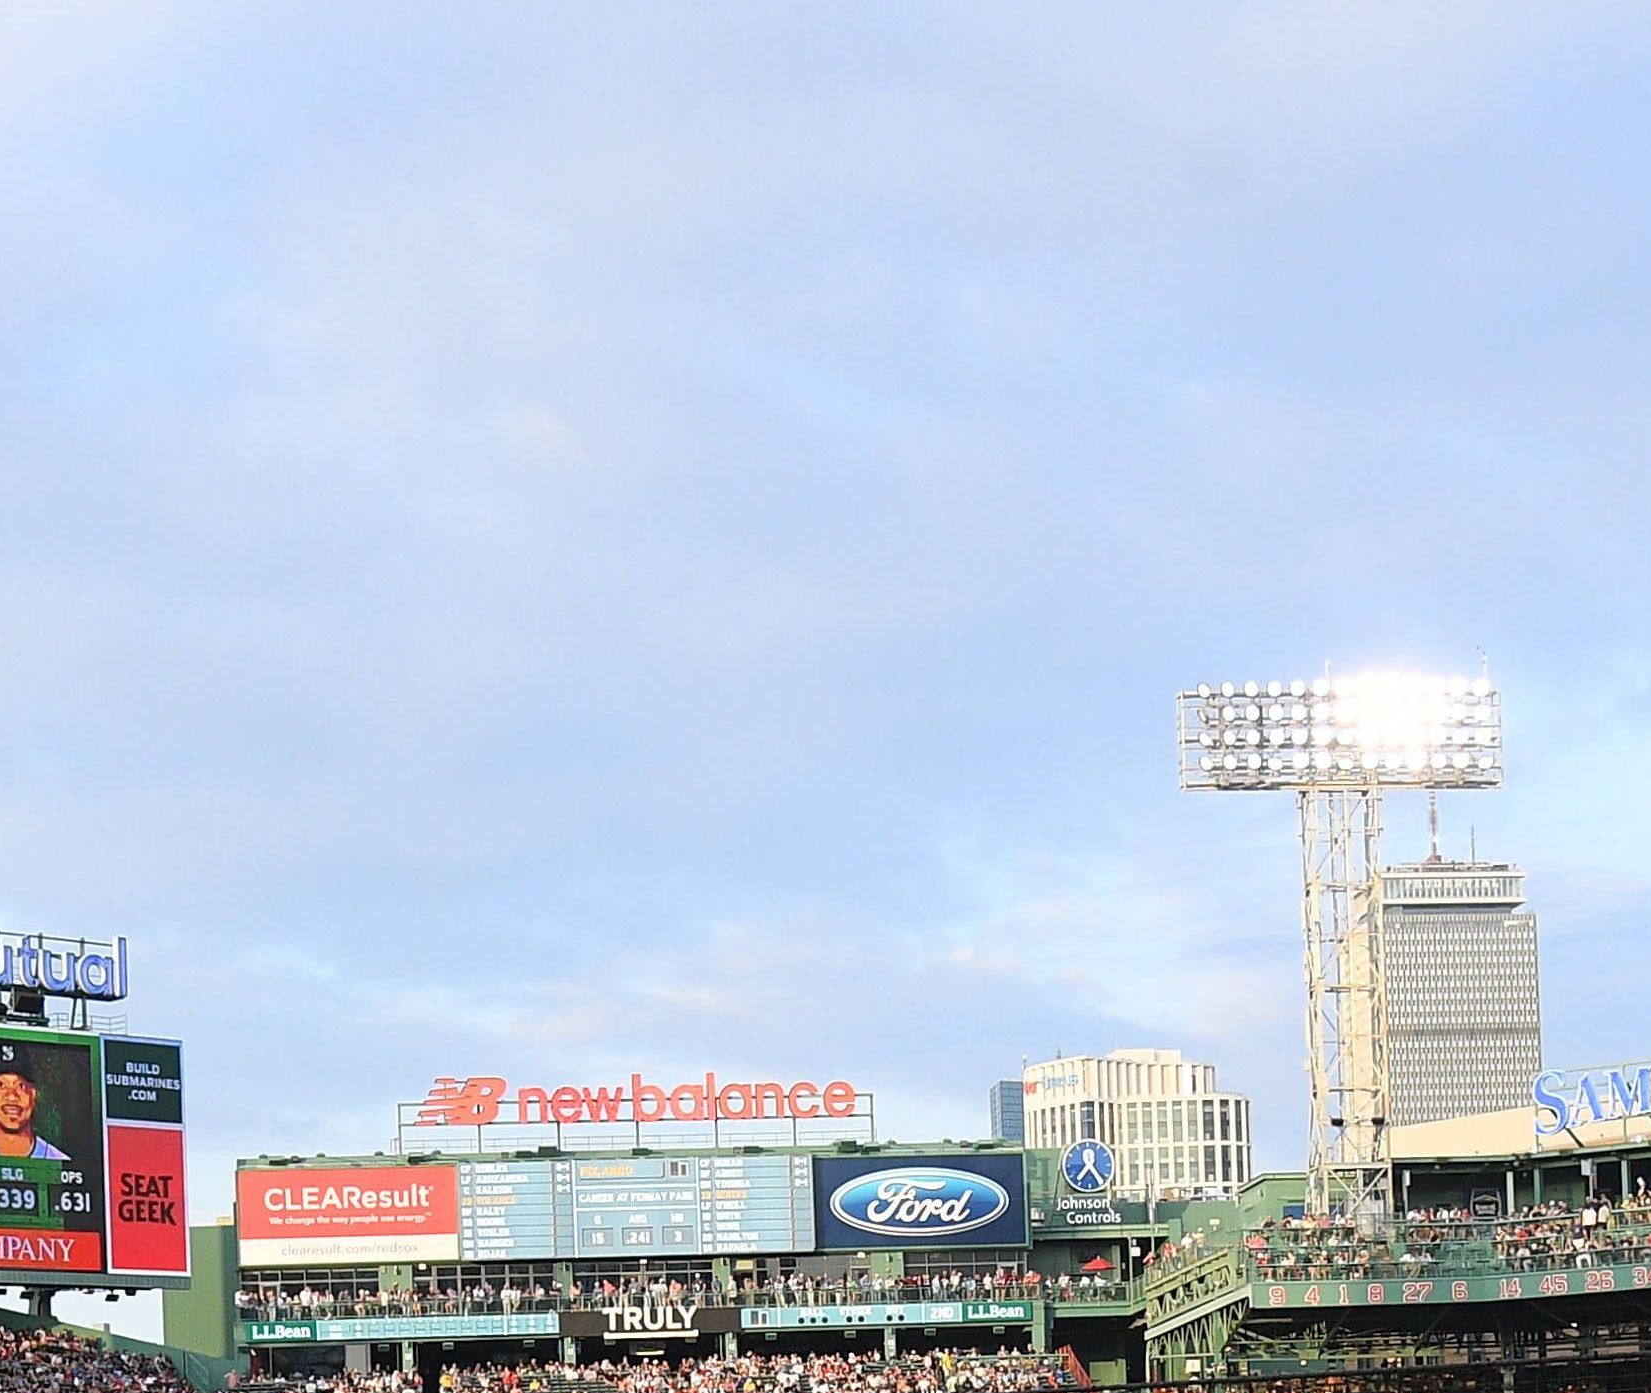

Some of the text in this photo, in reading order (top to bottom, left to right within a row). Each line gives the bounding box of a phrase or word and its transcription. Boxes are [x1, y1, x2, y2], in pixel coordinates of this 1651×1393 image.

[125, 1061, 161, 1075] BUILD
[106, 1075, 181, 1091] SUBMARINES
[60, 1170, 84, 1185] OPS
[120, 1172, 173, 1199] SEAT
[54, 1191, 91, 1213] .631
[263, 1182, 430, 1213] CLEAResult
[866, 1178, 974, 1224] Ford
[1056, 1194, 1112, 1212] Johnson
[117, 1199, 178, 1226] GEEK
[268, 1215, 284, 1226] We
[284, 1214, 315, 1228] change
[316, 1213, 331, 1225] the
[331, 1215, 350, 1228] way
[350, 1213, 379, 1227] people
[1065, 1210, 1122, 1226] Controls
[1268, 1285, 1287, 1306] 9
[1303, 1285, 1320, 1306] 4
[1338, 1285, 1349, 1305] 1
[1367, 1284, 1385, 1304] 8
[1401, 1282, 1433, 1303] 27
[1451, 1281, 1468, 1302] 6
[1498, 1278, 1522, 1299] 14
[1538, 1274, 1568, 1296] 45
[1584, 1270, 1615, 1293] 26
[602, 1305, 697, 1332] TRULY
[966, 1305, 1025, 1320] L.L.Bean
[251, 1324, 312, 1340] L.L.Bean
